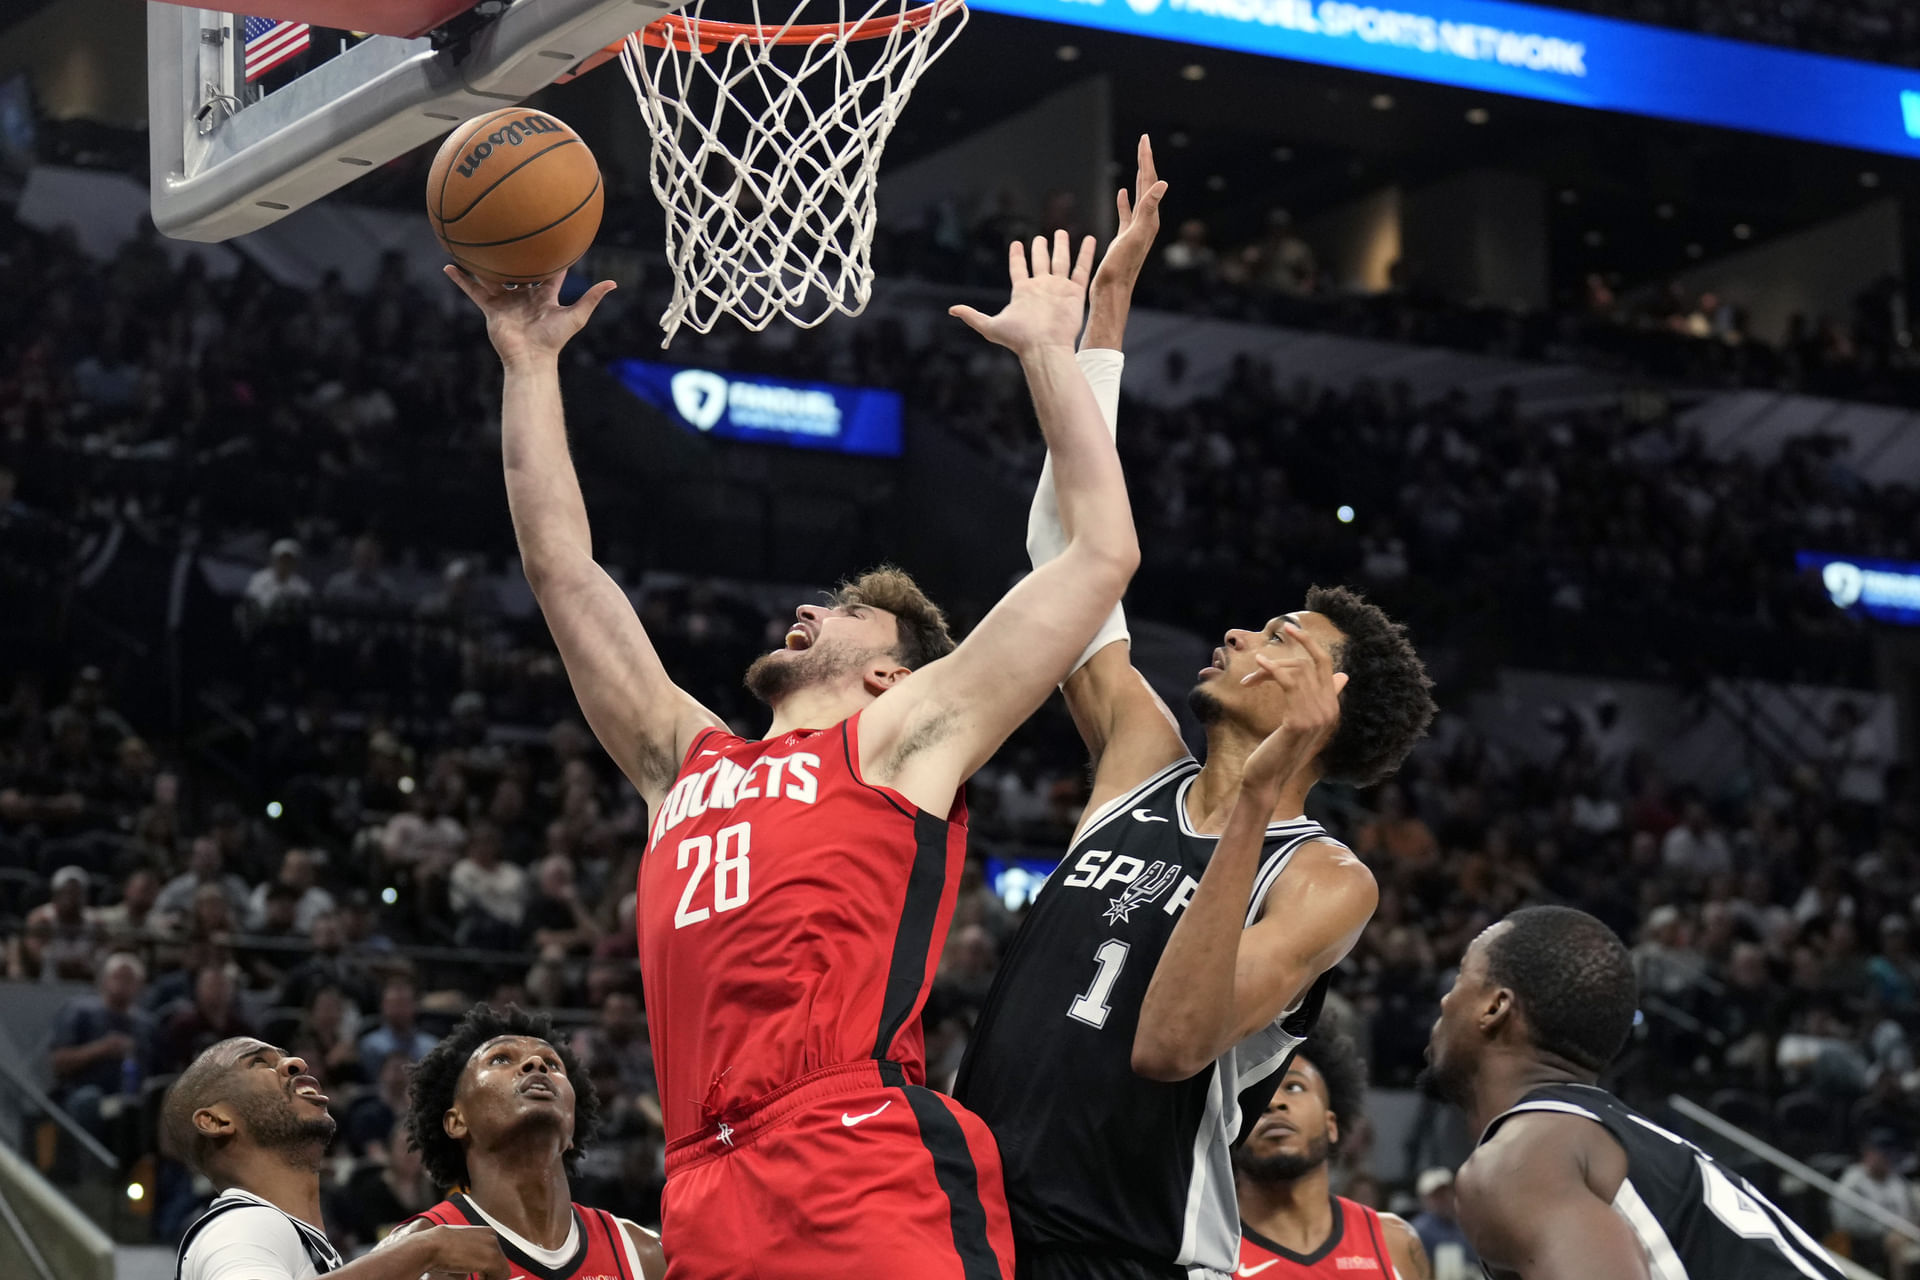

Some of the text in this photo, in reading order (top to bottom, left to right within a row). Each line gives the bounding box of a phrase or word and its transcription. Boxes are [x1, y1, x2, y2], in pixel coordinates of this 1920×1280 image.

[456, 115, 563, 178] Wilson
[651, 752, 820, 855] ROCKETS
[674, 821, 751, 930] 28
[1063, 850, 1200, 926] SPUR
[1067, 938, 1131, 1030] 1
